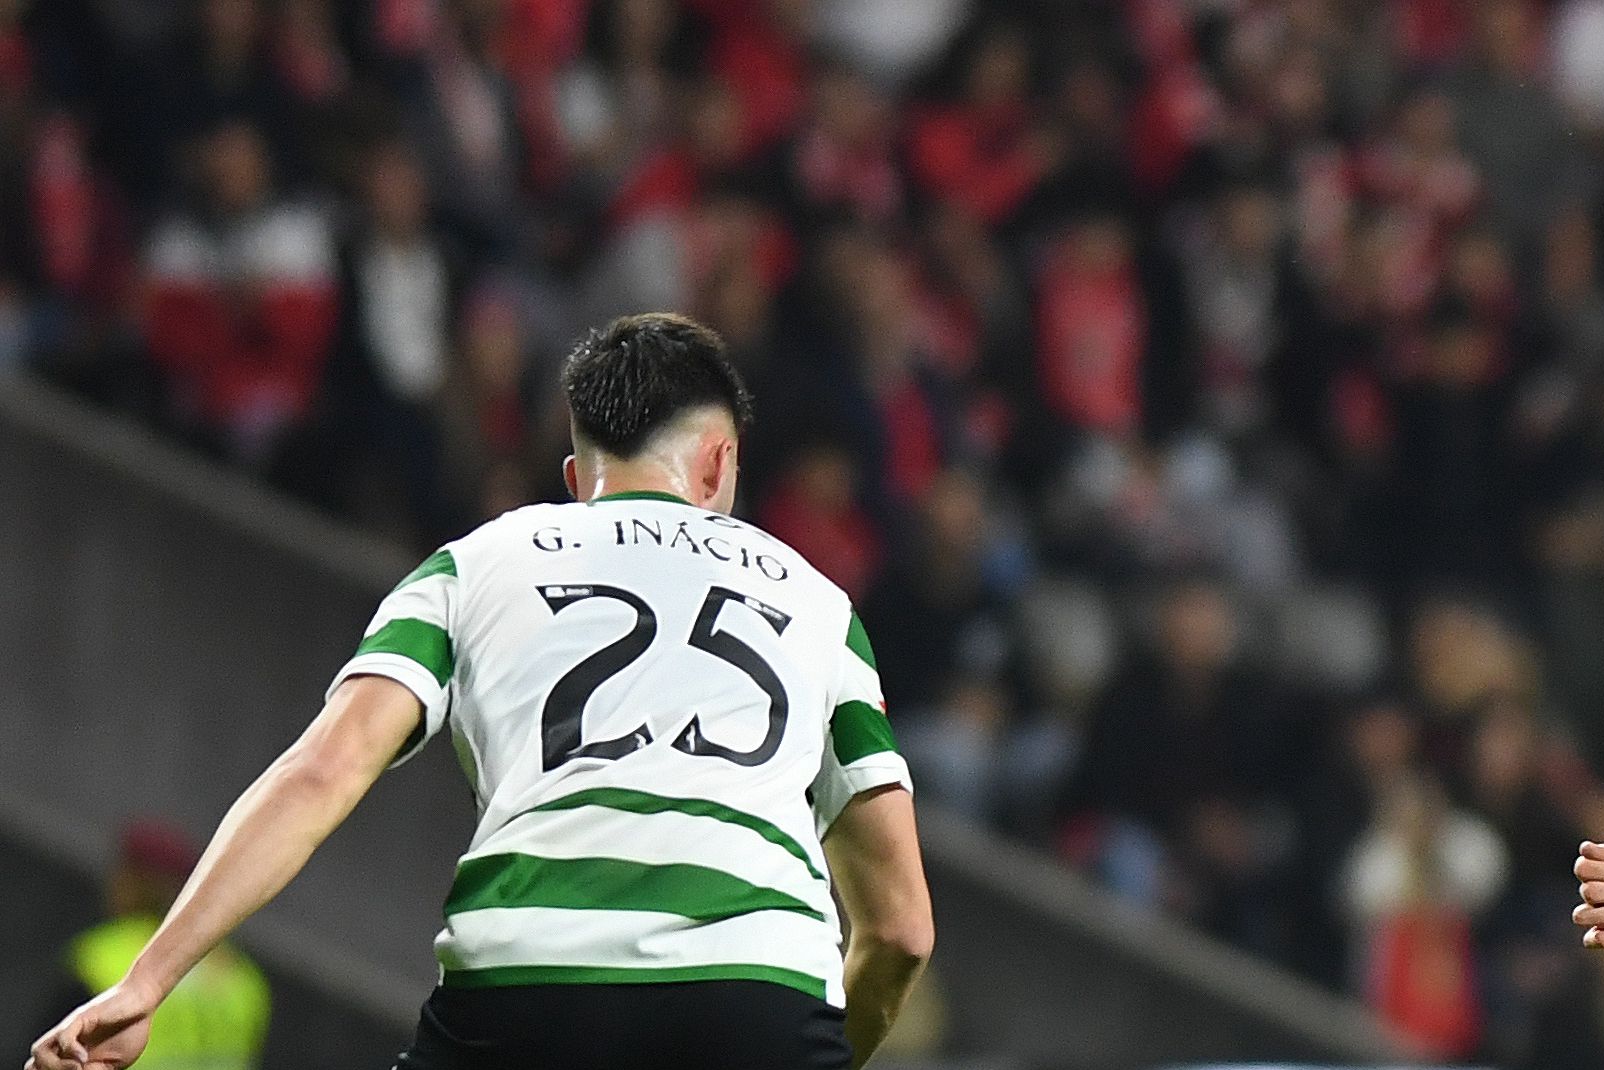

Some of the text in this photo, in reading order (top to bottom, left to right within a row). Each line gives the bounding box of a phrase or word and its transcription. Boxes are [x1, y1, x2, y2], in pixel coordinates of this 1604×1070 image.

[532, 526, 582, 552] G.
[614, 518, 788, 581] INÁCIO
[535, 584, 793, 773] 25
